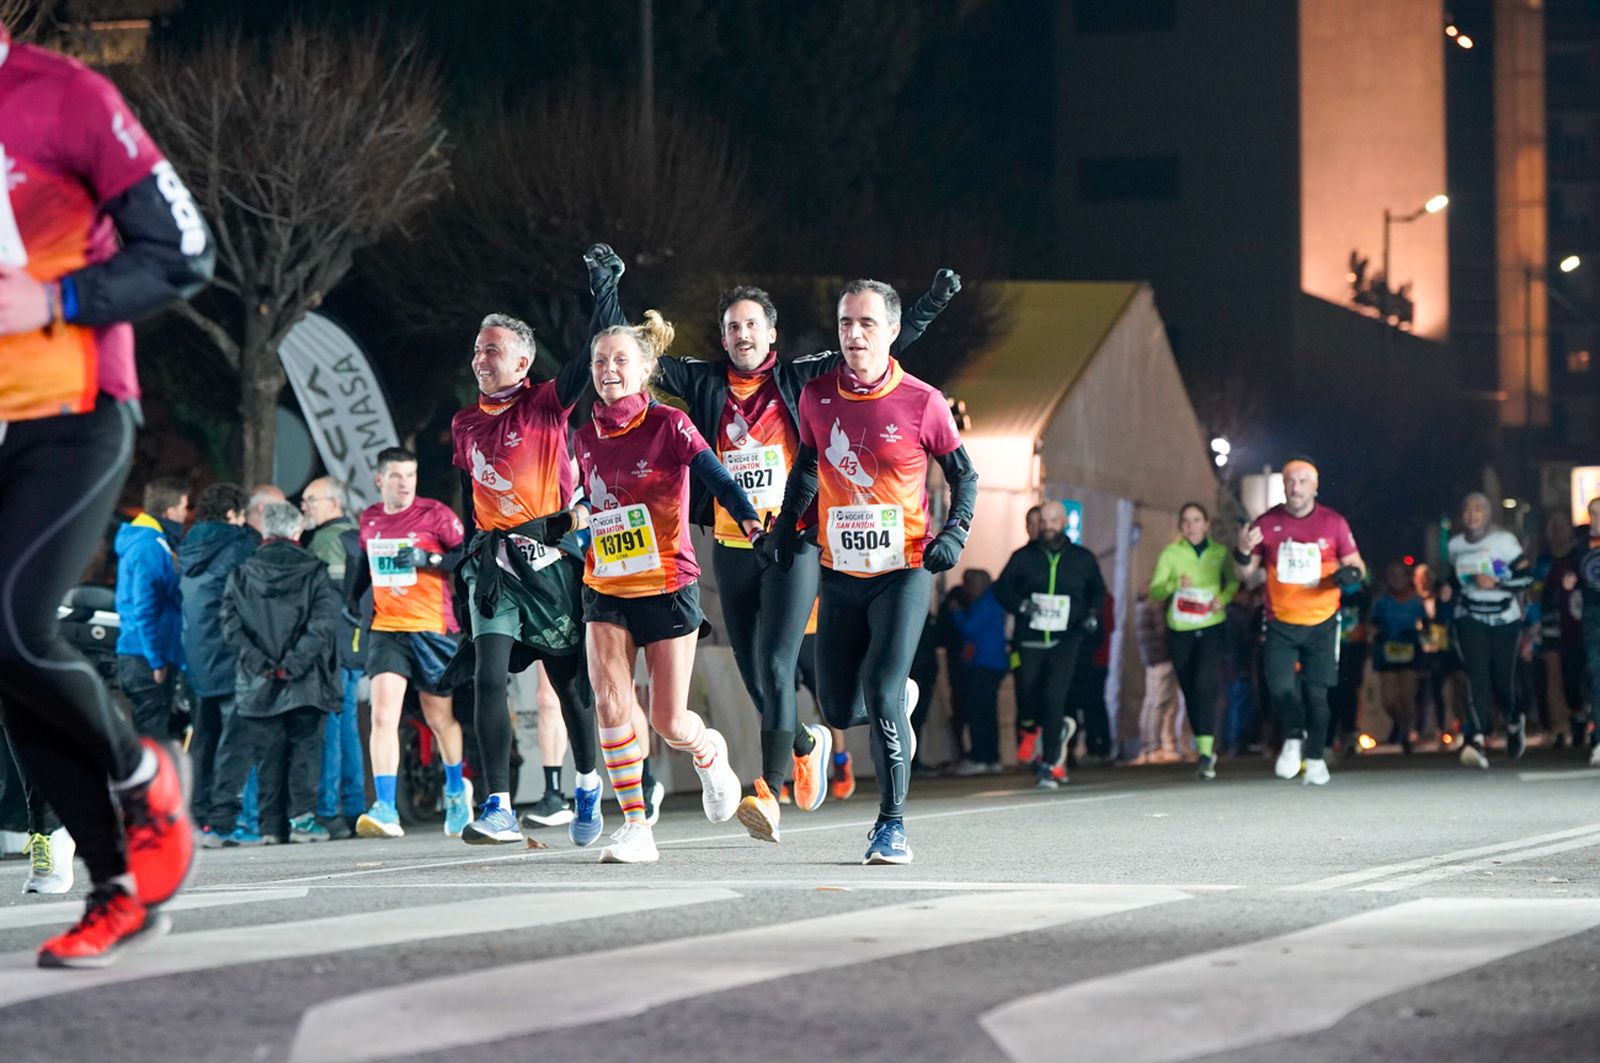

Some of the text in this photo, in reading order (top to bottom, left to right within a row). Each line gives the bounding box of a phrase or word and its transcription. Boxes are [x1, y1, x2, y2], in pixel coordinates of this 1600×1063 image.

[838, 456, 858, 476] 43
[481, 469, 496, 485] 43
[735, 469, 772, 489] 6627
[600, 528, 645, 556] 13791
[841, 530, 891, 550] 6504
[519, 543, 545, 561] 626
[879, 718, 903, 761] NIKE
